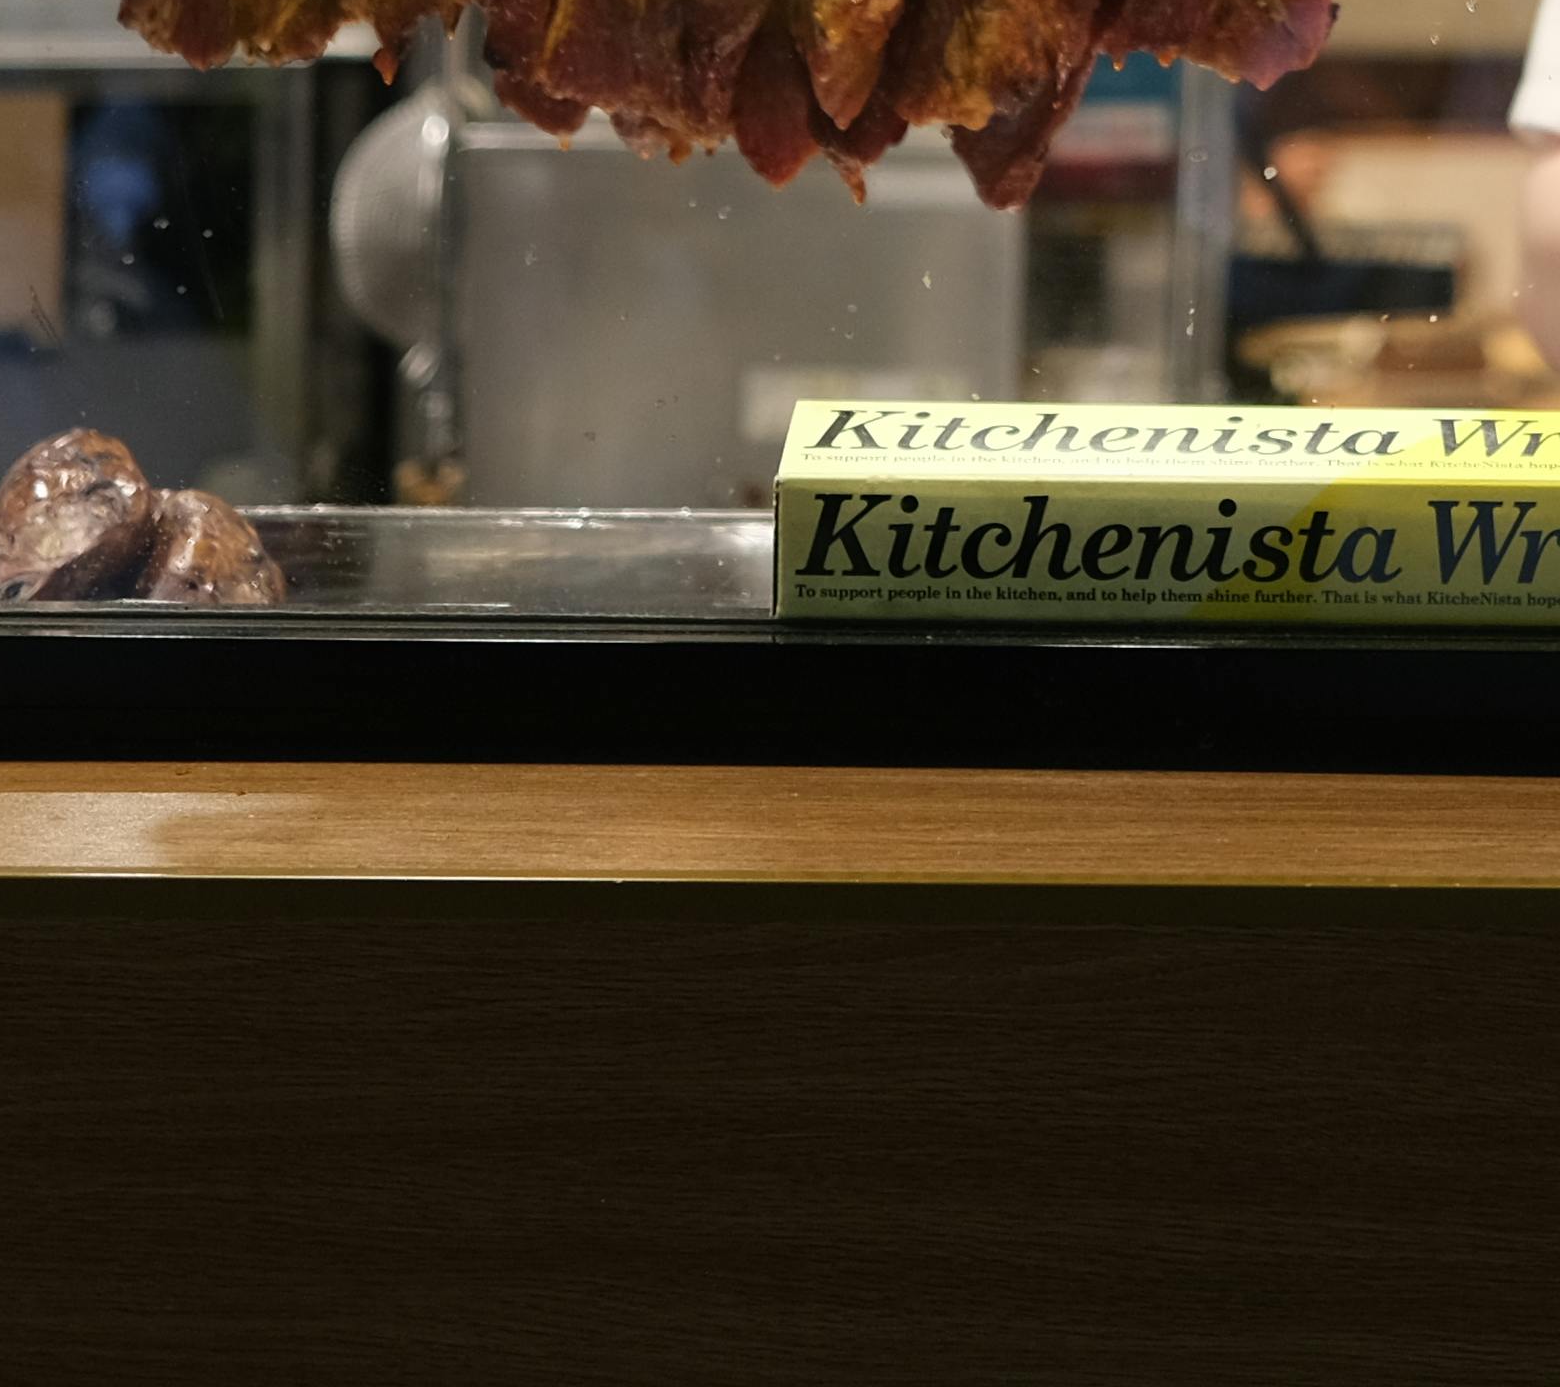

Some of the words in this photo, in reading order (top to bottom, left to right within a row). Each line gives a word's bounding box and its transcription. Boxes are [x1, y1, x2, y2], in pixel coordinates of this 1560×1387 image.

[804, 410, 1406, 456] Kitchenista
[825, 454, 887, 463] support
[1384, 459, 1424, 467] what
[793, 492, 1403, 584] Kitchenista
[795, 584, 816, 598] To
[820, 586, 882, 601] support
[888, 586, 941, 602] people
[946, 586, 961, 599] in
[966, 586, 992, 600] the
[996, 586, 1063, 602] kitchen,
[1066, 587, 1096, 601] and
[1101, 589, 1118, 601] to
[1122, 587, 1157, 604] help
[1161, 588, 1203, 601] them
[1205, 590, 1250, 603] shine
[1253, 590, 1318, 604] further.
[1321, 591, 1359, 604] That
[1364, 591, 1378, 604] is
[1381, 591, 1421, 605] what
[1425, 592, 1522, 606] KitcheNista
